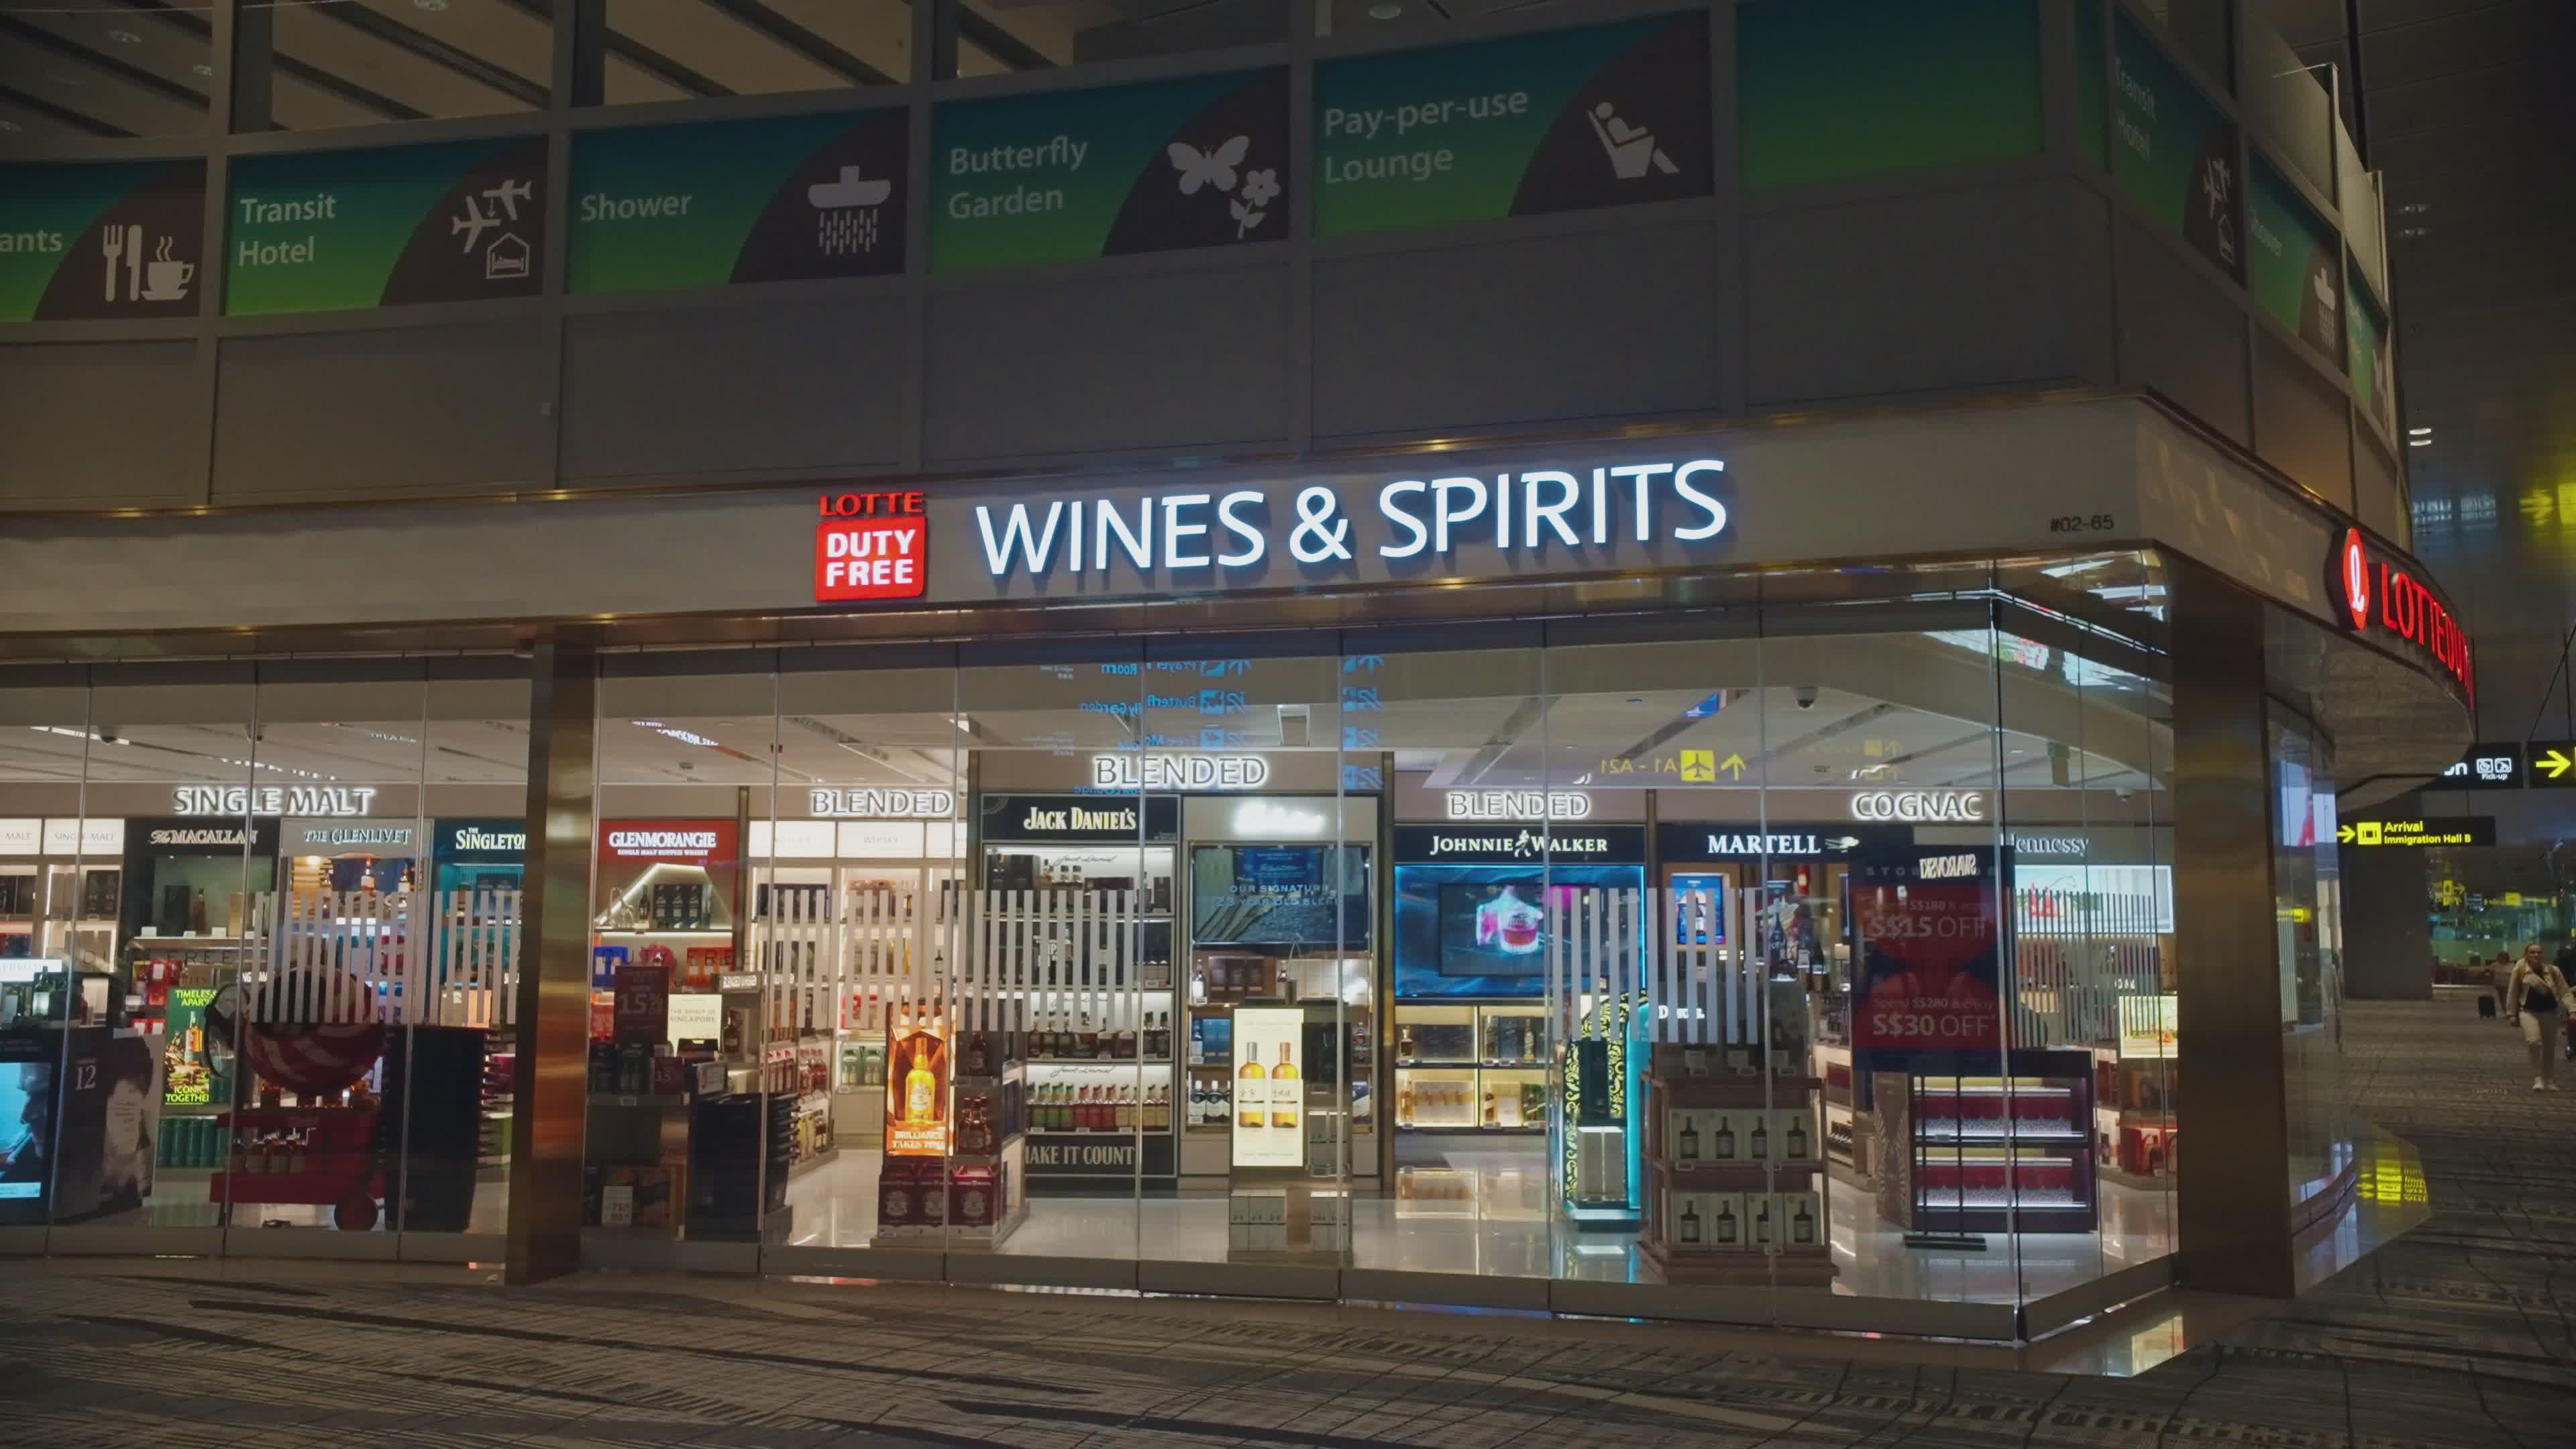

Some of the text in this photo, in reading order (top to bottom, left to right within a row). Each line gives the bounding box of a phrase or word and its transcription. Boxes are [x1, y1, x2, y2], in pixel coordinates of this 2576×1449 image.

[1325, 91, 1529, 138] Pay-per-use
[950, 136, 1087, 174] Butterfly
[1325, 149, 1454, 183] Lounge
[241, 193, 336, 224] Transit
[580, 191, 692, 221] Shower
[949, 186, 1064, 220] Garden
[239, 237, 315, 266] Hotel
[819, 492, 924, 516] LOTTE
[975, 460, 1726, 574] WINES & SPIRITS
[2051, 515, 2114, 531] #02-65
[826, 529, 915, 558] DUTY
[826, 559, 913, 586] FREE
[2381, 563, 2447, 663] LOTTE
[1092, 754, 1268, 790] BLENDED
[173, 786, 376, 816] SINGLE MALT
[811, 788, 954, 817] BLENDED
[1447, 792, 1590, 819] BLENDED
[1851, 792, 1982, 820] COGNAC
[1024, 807, 1136, 830] JACK DANIEL'S
[2384, 821, 2423, 833] Arrival
[54, 832, 87, 842] SINGE
[171, 829, 258, 845] MACALLAN
[305, 827, 411, 845] THE GLENLIVET
[609, 832, 716, 848] GLENMORANGIE
[1430, 835, 1608, 855] JOHNNIE WALKER
[1708, 835, 1821, 854] MARTELL
[2000, 833, 2090, 857] Hennessy
[2384, 835, 2471, 845] Immigration Hall B
[1873, 1012, 1935, 1039] S$30
[174, 1086, 205, 1094] ICONIC
[1063, 1146, 1081, 1165] IT
[1083, 1145, 1136, 1165] COUNT
